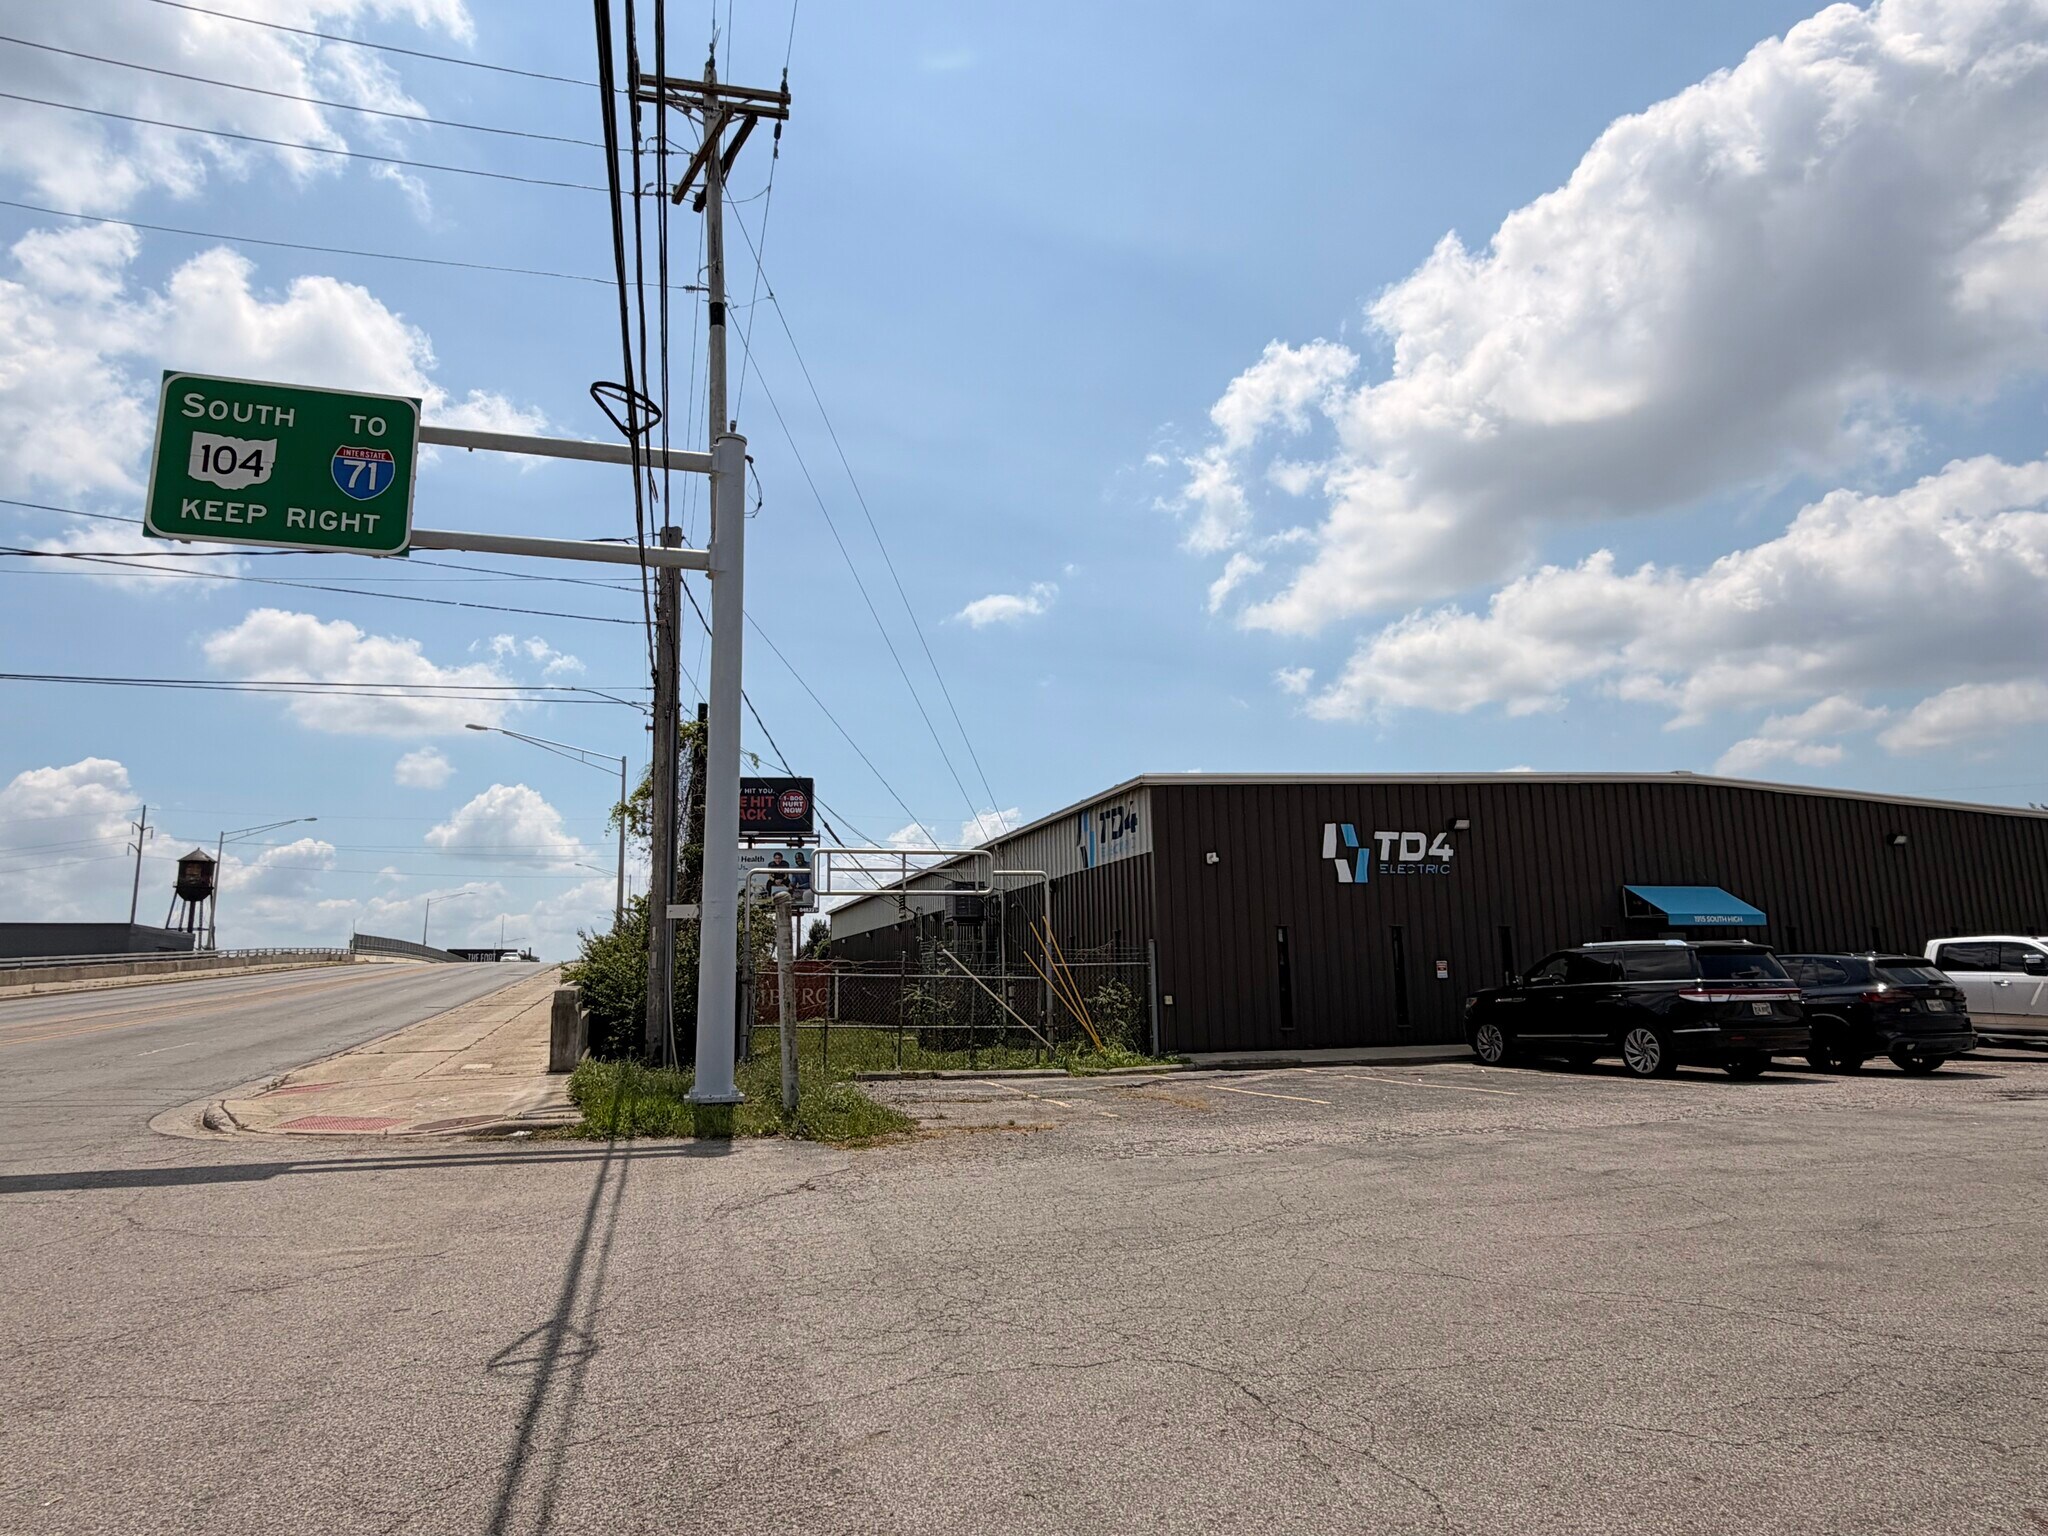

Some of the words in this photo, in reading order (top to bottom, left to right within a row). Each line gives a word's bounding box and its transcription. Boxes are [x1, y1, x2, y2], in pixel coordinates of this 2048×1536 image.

[181, 392, 296, 428] SOUTH
[350, 414, 387, 437] TO
[201, 444, 264, 478] 104
[342, 449, 386, 460] INTERSTATE
[343, 459, 377, 490] 71
[181, 498, 267, 524] KEEP
[286, 507, 381, 534] RIGHT
[750, 795, 775, 807] HIT
[1099, 800, 1138, 844] TD4
[1374, 831, 1454, 862] TD4
[1379, 863, 1451, 875] ELECTRIC
[1706, 915, 1728, 923] SOUTH
